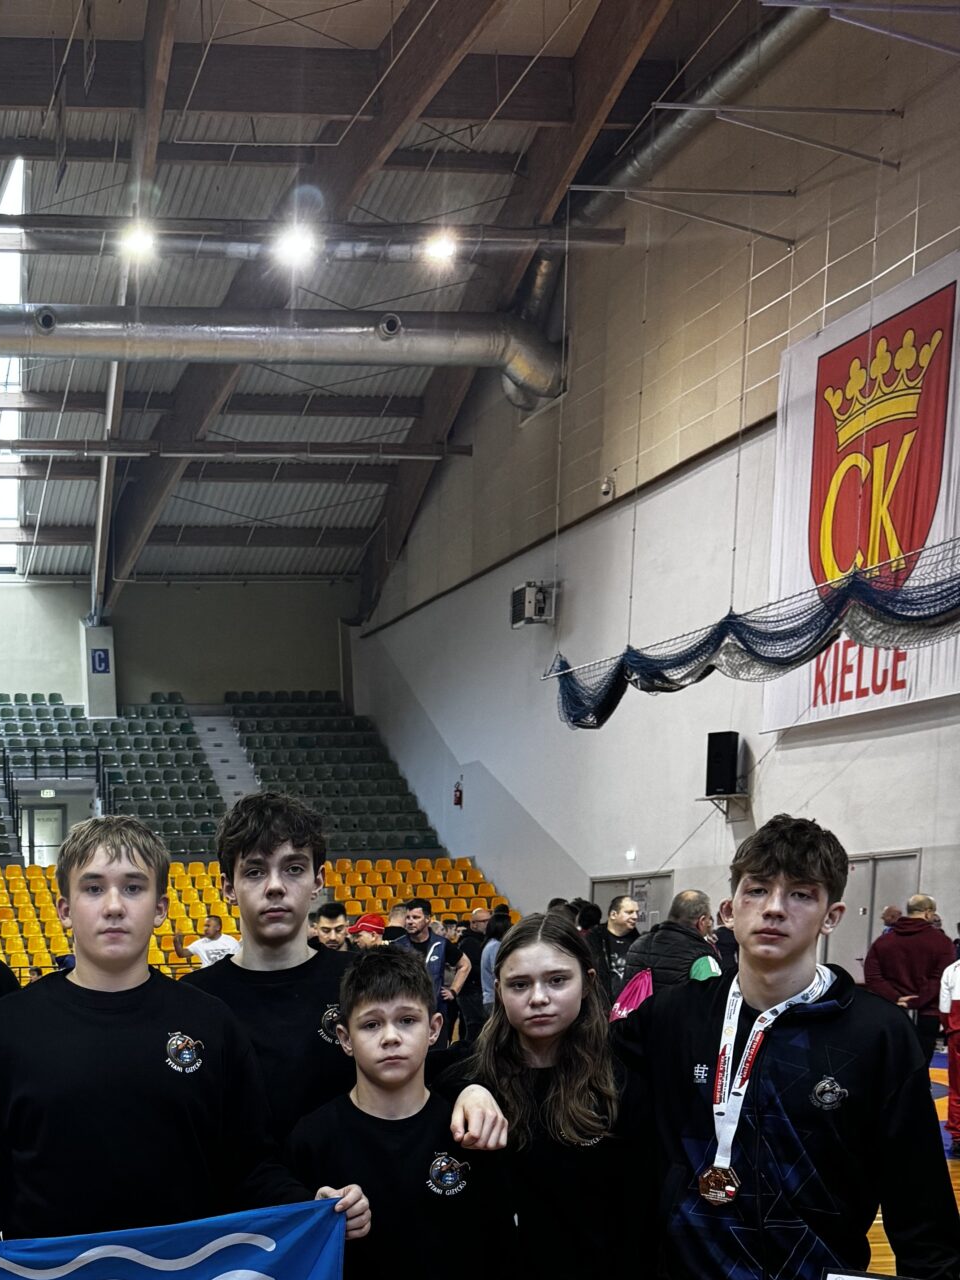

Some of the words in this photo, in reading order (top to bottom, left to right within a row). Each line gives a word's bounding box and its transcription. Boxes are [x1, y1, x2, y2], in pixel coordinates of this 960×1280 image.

[819, 428, 917, 590] CK
[95, 650, 105, 671] C
[812, 639, 908, 708] KIELCE
